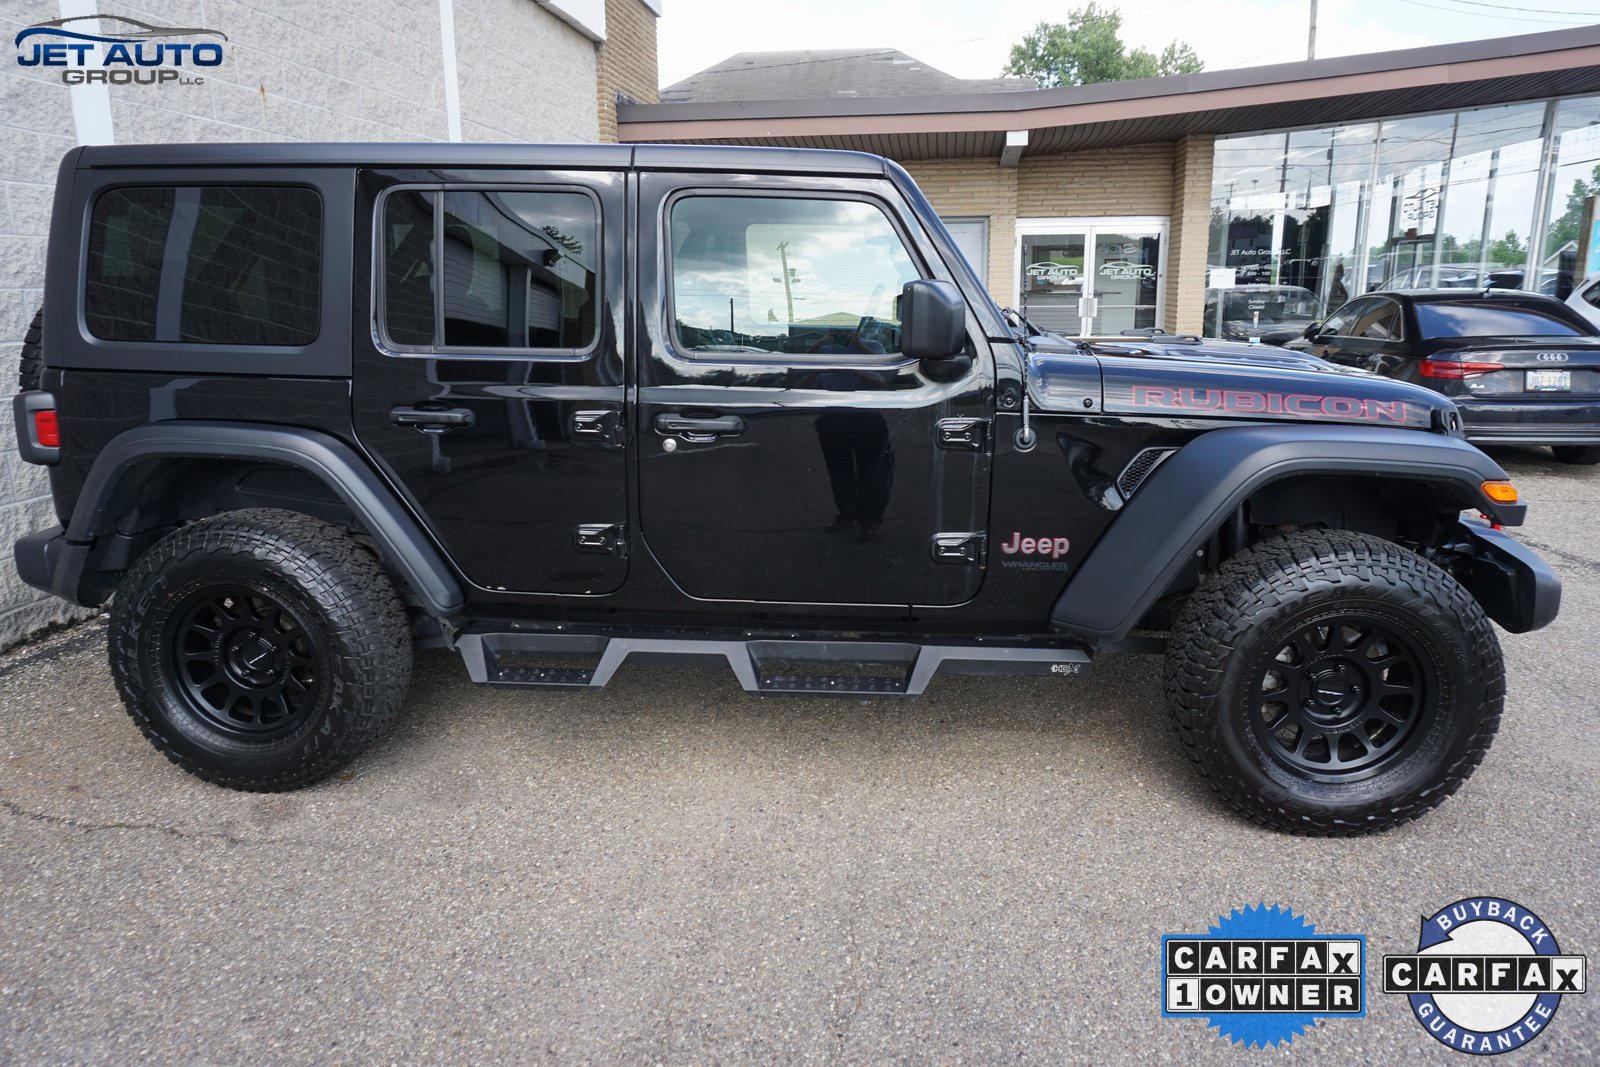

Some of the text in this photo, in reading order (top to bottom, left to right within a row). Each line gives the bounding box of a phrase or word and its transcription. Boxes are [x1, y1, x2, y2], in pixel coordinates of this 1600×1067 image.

[1240, 248, 1257, 256] Auto
[1026, 268, 1078, 276] JET AUTO
[1131, 385, 1407, 421] RUBICON
[1001, 532, 1070, 559] Jeep
